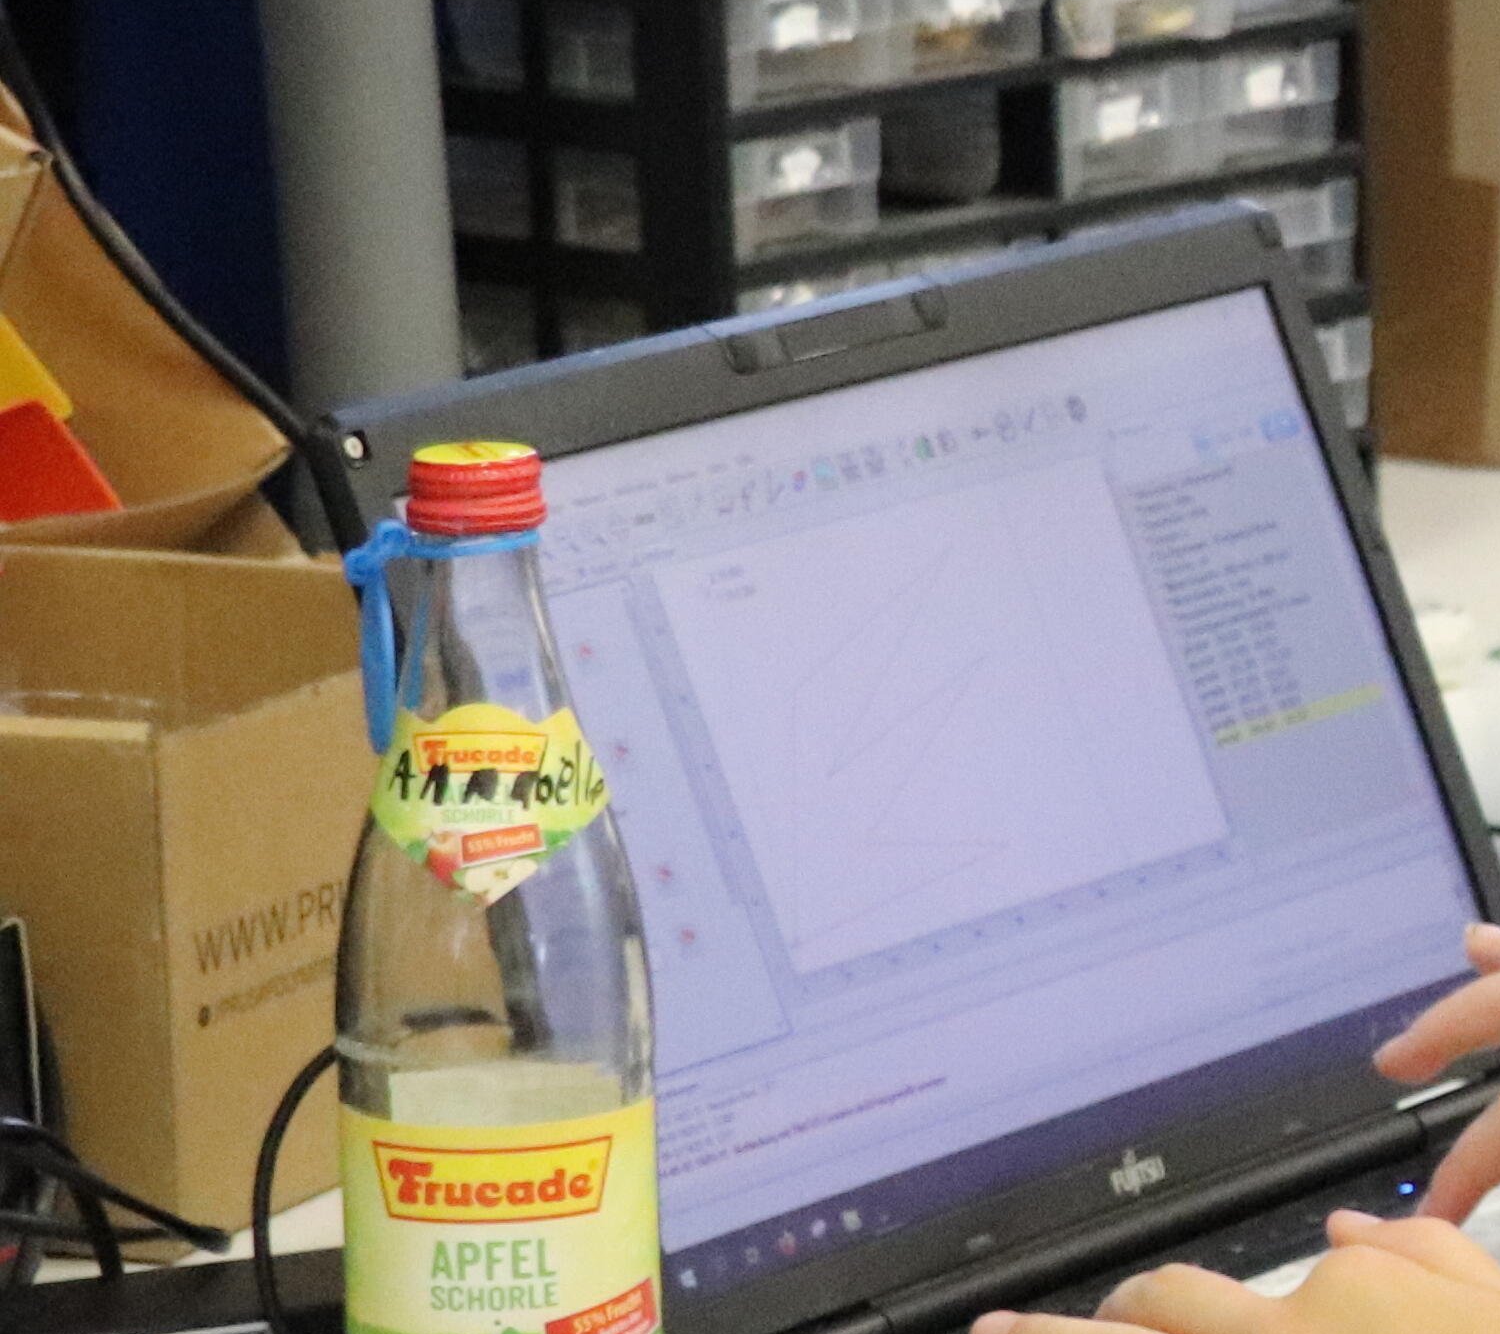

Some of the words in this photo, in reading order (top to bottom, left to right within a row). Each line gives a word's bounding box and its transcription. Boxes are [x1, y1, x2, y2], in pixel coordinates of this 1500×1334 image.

[194, 879, 343, 975] WWW.PR
[387, 1158, 594, 1207] Frucade
[430, 1238, 558, 1281] APFEL
[430, 1282, 559, 1312] SCHORLE
